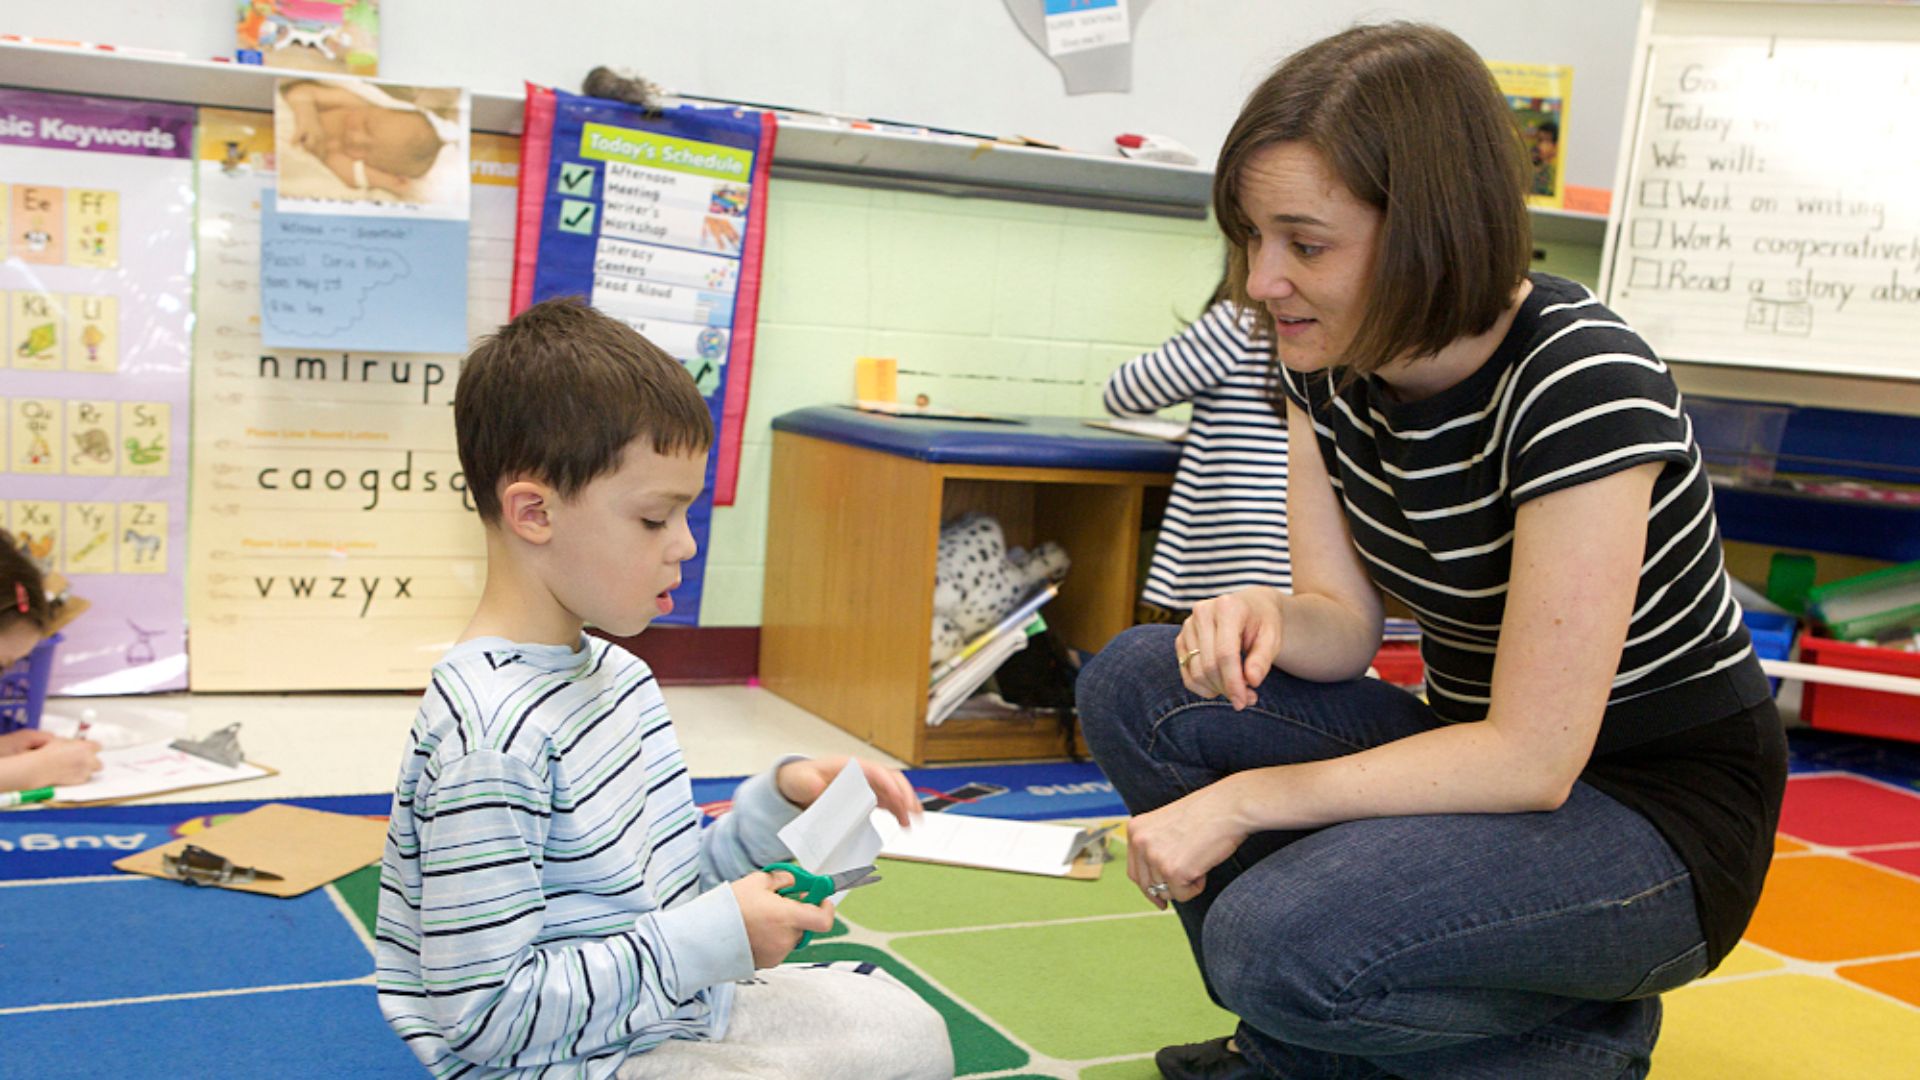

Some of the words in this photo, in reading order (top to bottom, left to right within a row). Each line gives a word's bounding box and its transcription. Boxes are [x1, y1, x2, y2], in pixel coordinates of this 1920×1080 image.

[1657, 100, 1733, 142] Today
[40, 117, 175, 148] Keywords
[590, 132, 656, 160] Today's
[662, 146, 743, 173] Schedule
[1651, 140, 1686, 171] We
[609, 165, 677, 186] Afternoon
[608, 183, 661, 203] Meeting
[605, 200, 660, 219] Writer's
[1750, 195, 1778, 213] on
[604, 218, 668, 239] Workshop
[1671, 220, 1732, 251] Work
[598, 242, 655, 263] Literacy
[595, 260, 647, 278] Centers
[594, 277, 629, 294] Read
[636, 283, 673, 300] Aloud
[1667, 259, 1734, 293] Read
[1749, 277, 1765, 295] a
[1785, 268, 1856, 312] story
[1026, 781, 1114, 796] une
